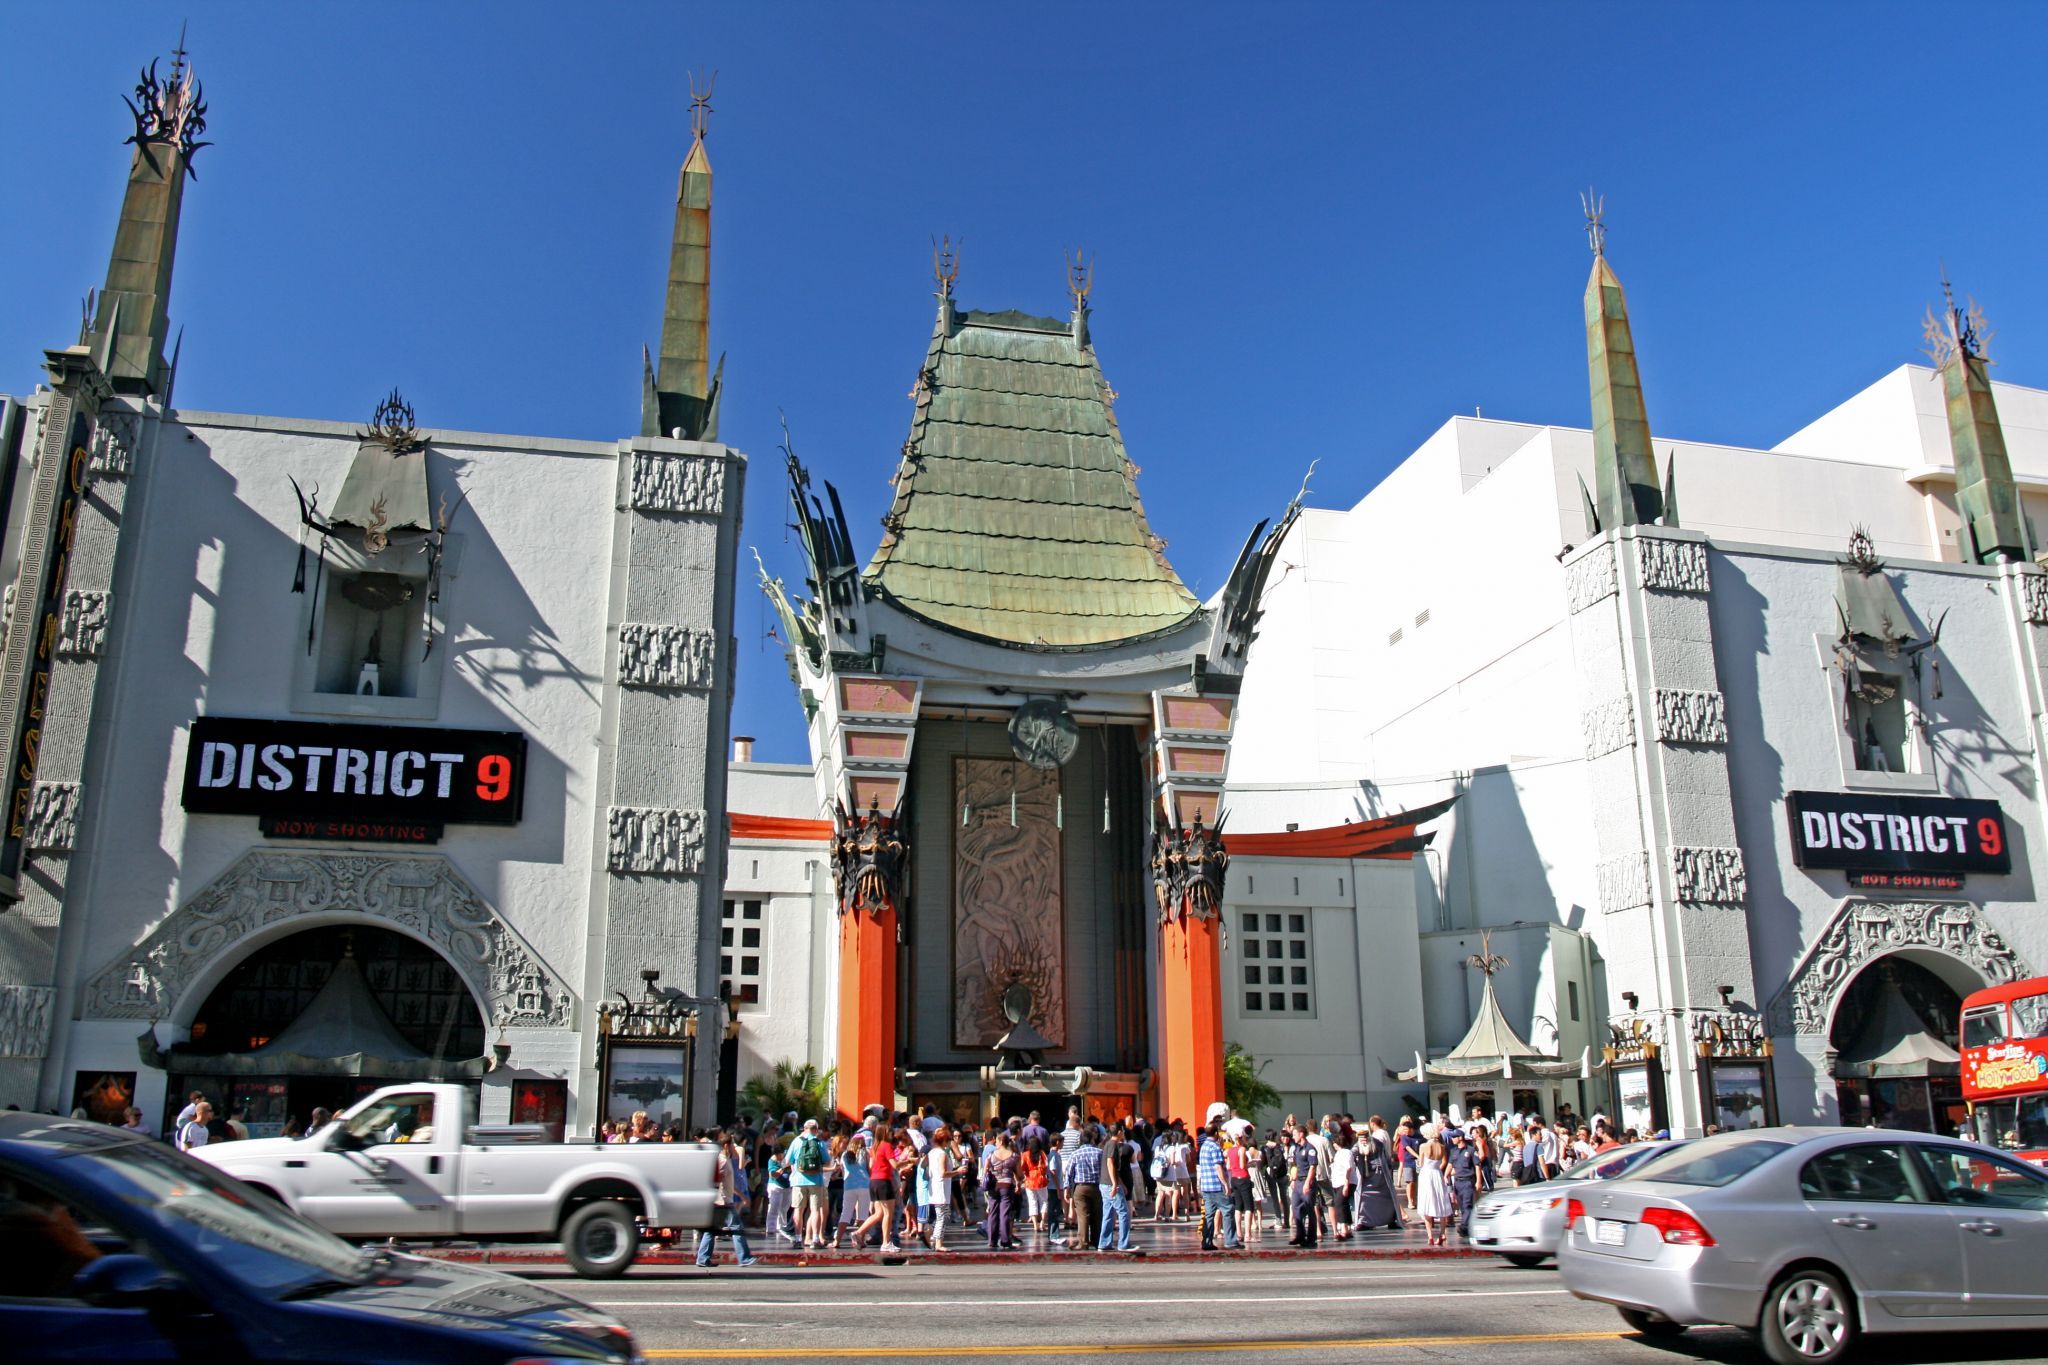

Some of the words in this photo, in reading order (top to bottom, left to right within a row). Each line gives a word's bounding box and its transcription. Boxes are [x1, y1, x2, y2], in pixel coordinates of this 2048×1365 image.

[199, 742, 464, 798] DISTRICT
[476, 755, 512, 801] 9
[275, 821, 318, 835] NOW
[327, 824, 427, 840] SHOWING
[1801, 811, 1968, 853] DISTRICT
[1977, 818, 2003, 855] 9
[1977, 1061, 2038, 1089] Hollywood
